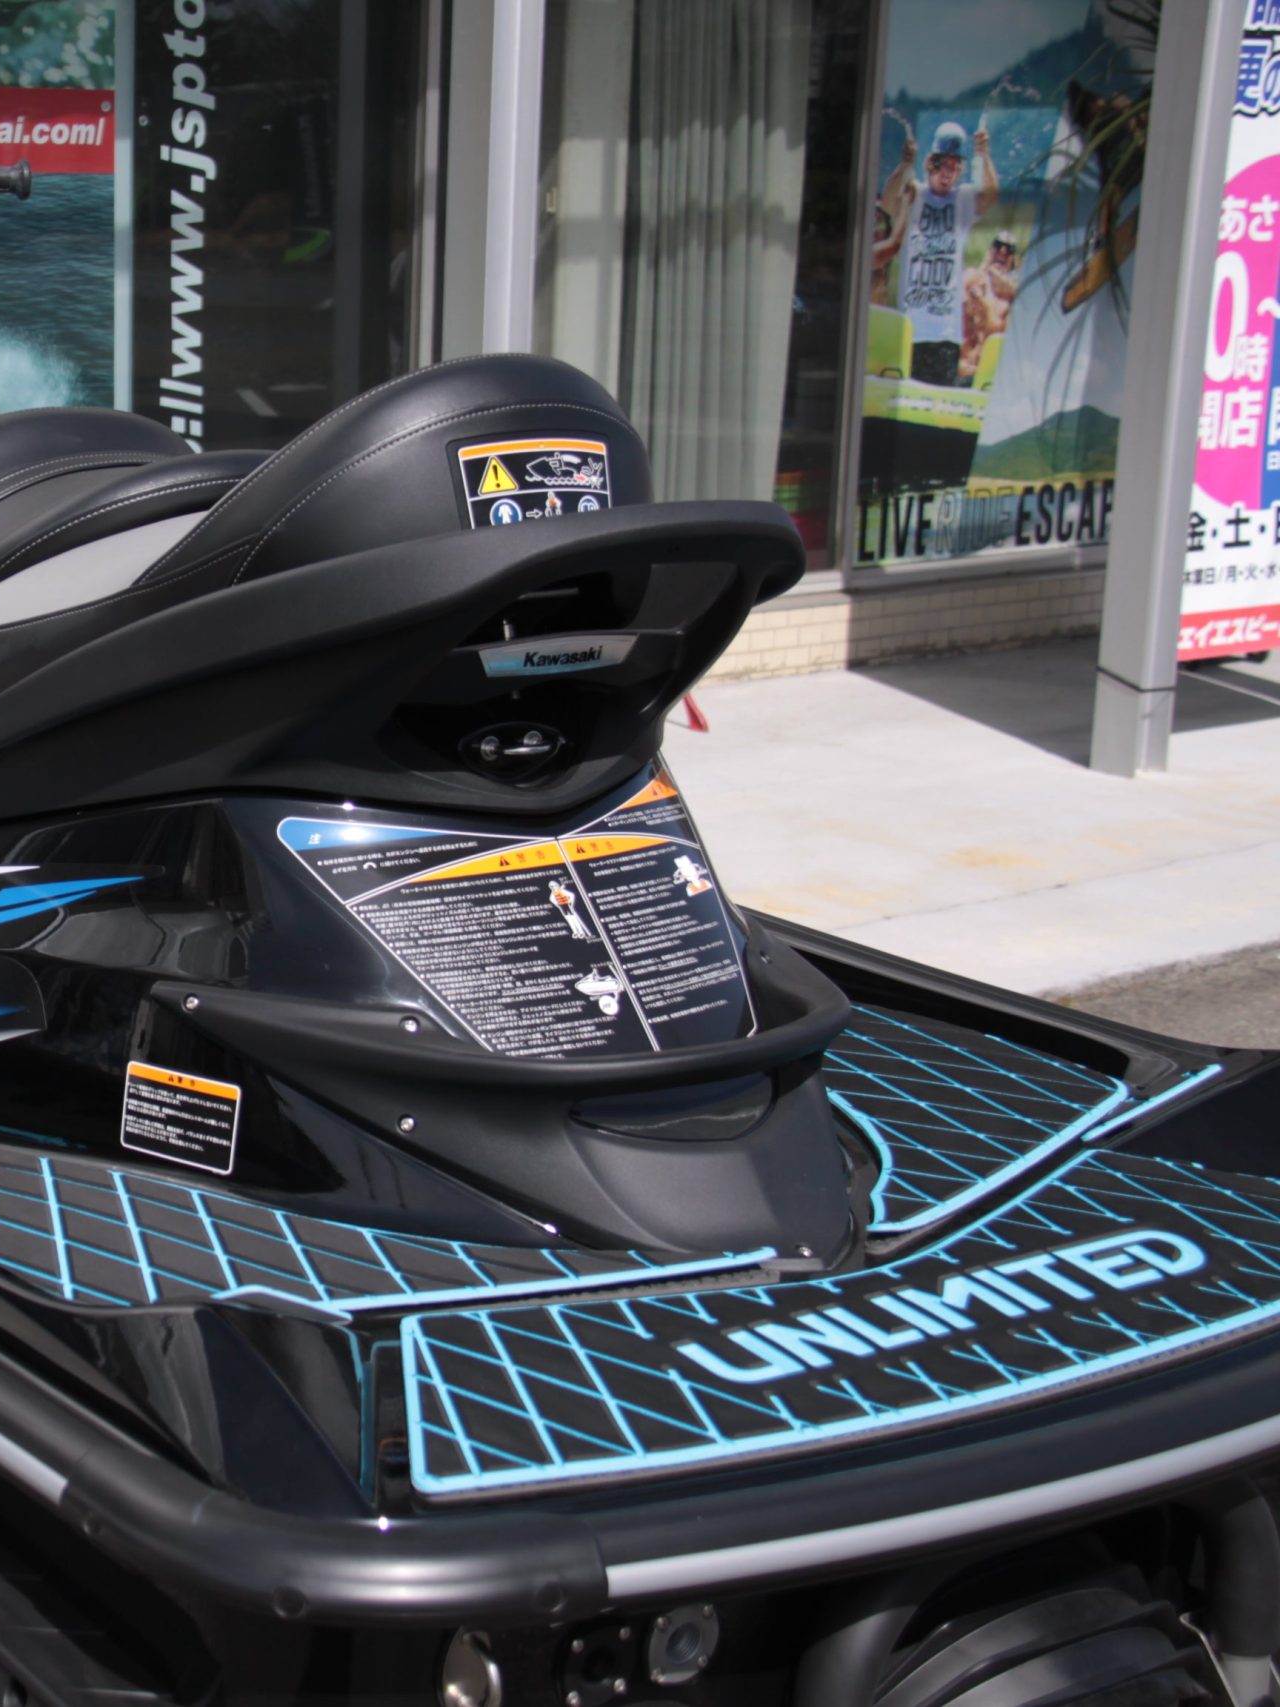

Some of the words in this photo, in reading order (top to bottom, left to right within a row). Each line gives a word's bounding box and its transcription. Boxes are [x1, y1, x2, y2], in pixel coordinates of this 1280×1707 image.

[857, 492, 934, 562] LIVE
[523, 646, 603, 668] Kawasaki
[677, 1229, 1207, 1384] UNLIMITED
